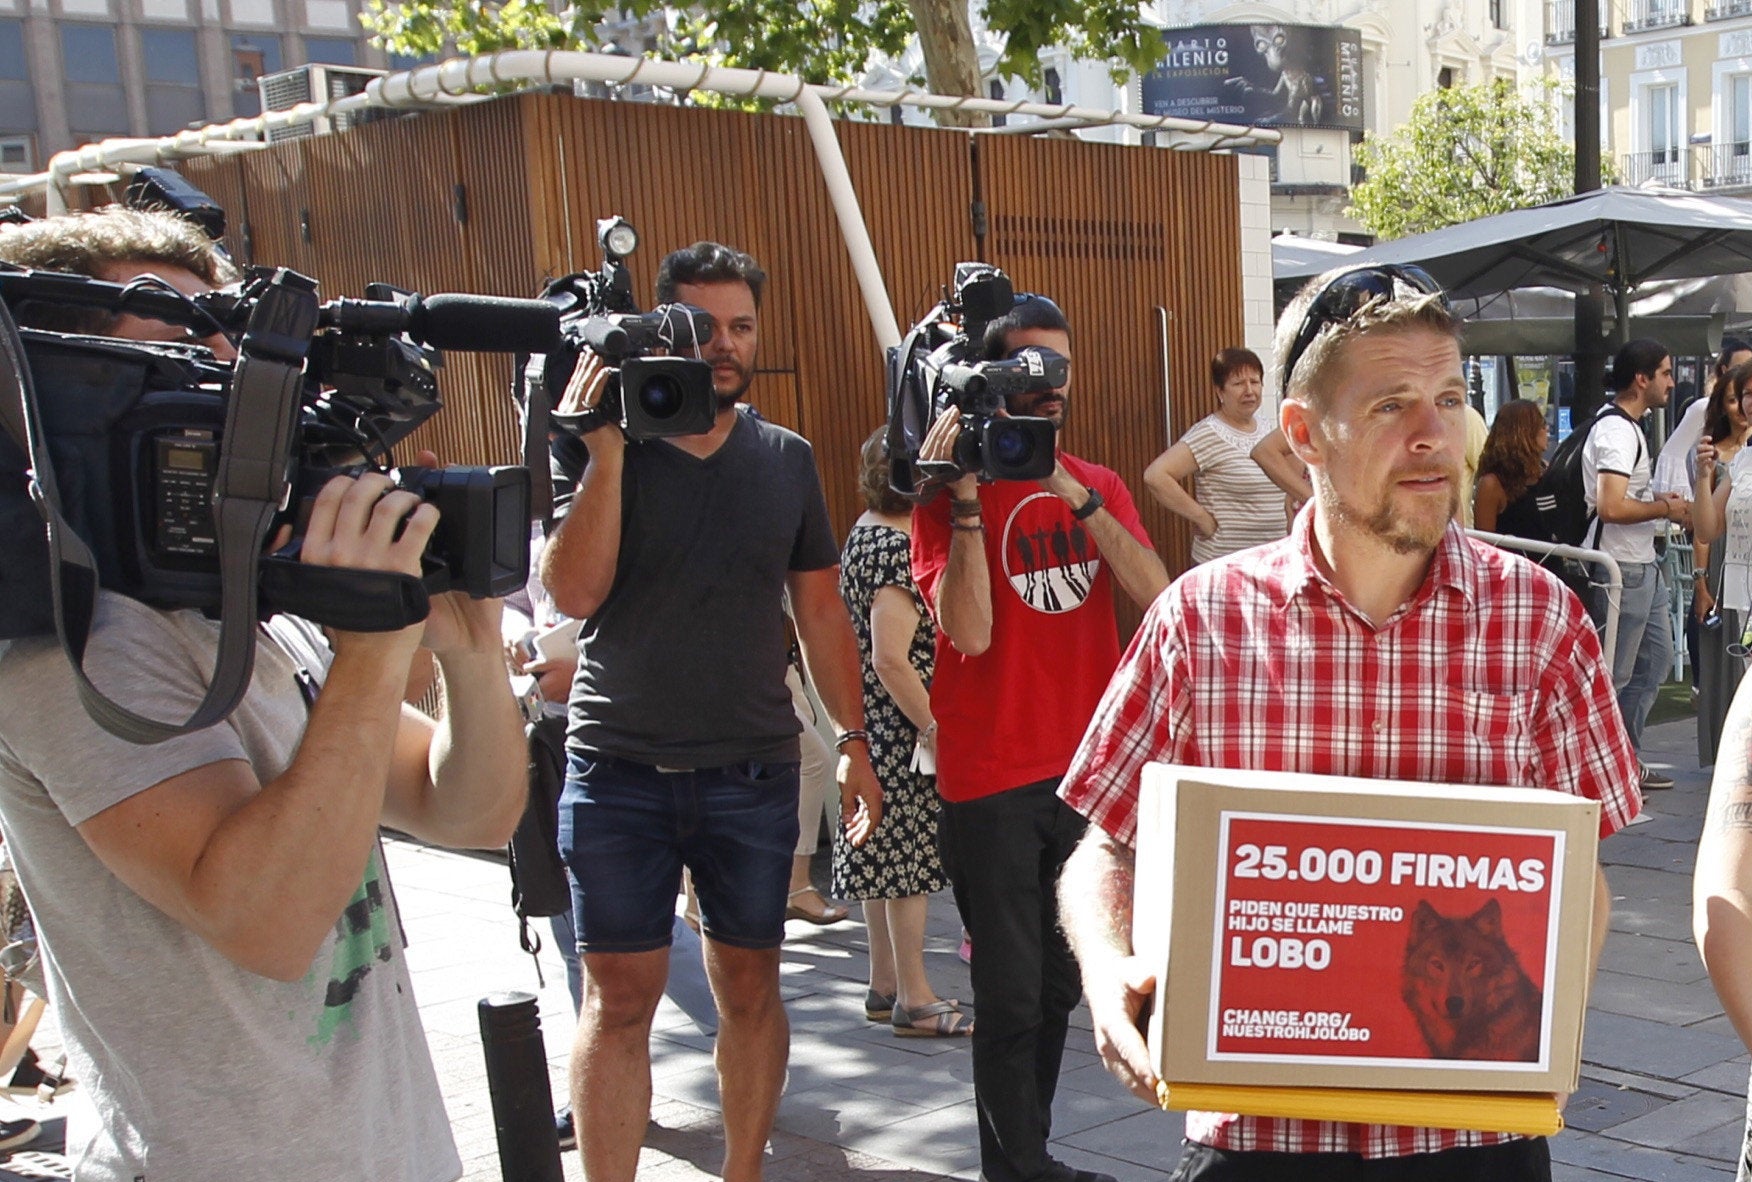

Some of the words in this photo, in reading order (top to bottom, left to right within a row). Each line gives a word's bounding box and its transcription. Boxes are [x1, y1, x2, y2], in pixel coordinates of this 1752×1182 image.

[1233, 843, 1383, 885] 25.000
[1389, 852, 1546, 893] FIRMAS
[1229, 900, 1281, 917] PIDEN
[1284, 902, 1320, 919] QUE
[1322, 904, 1404, 922] NUESTRO
[1228, 917, 1269, 933] HIJO
[1271, 918, 1294, 934] SE
[1297, 919, 1354, 936] LLAME
[1230, 936, 1332, 971] LOBO
[1223, 1009, 1352, 1030] CHANGE.ORG/
[1223, 1025, 1371, 1042] NUESTROHIJOLOBO
